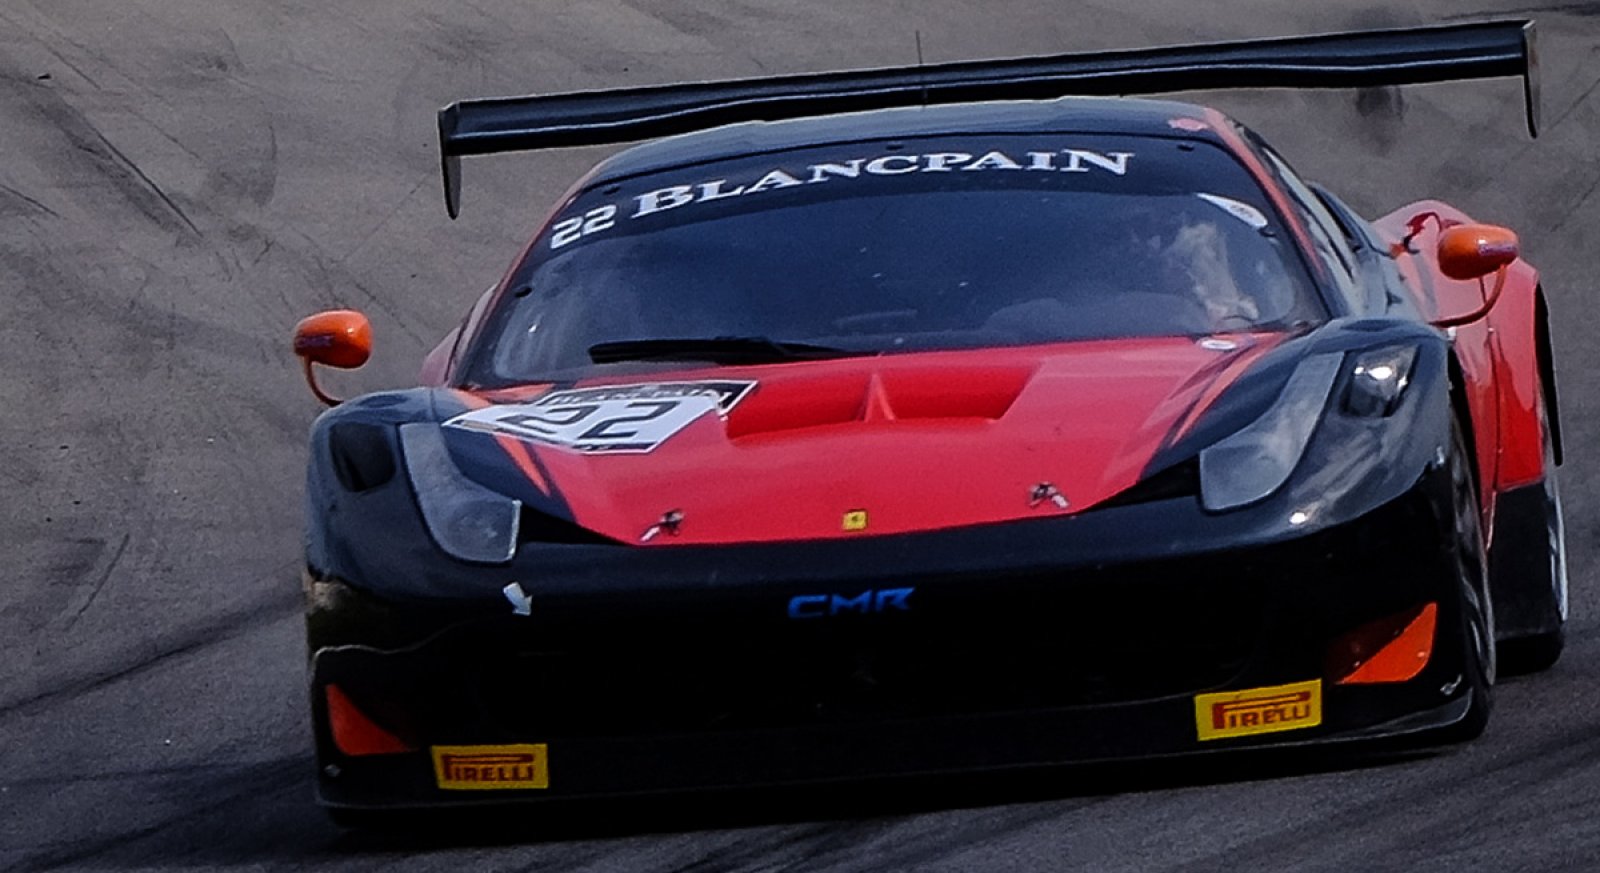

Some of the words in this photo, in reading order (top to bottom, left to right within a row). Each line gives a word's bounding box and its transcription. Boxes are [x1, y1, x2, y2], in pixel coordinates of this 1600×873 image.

[550, 204, 618, 250] 22
[631, 147, 1135, 219] BLANCPAIN
[495, 401, 681, 439] 22
[787, 586, 916, 618] CMR
[1211, 691, 1311, 730] PIRELLI
[441, 753, 535, 782] PIRELLI
